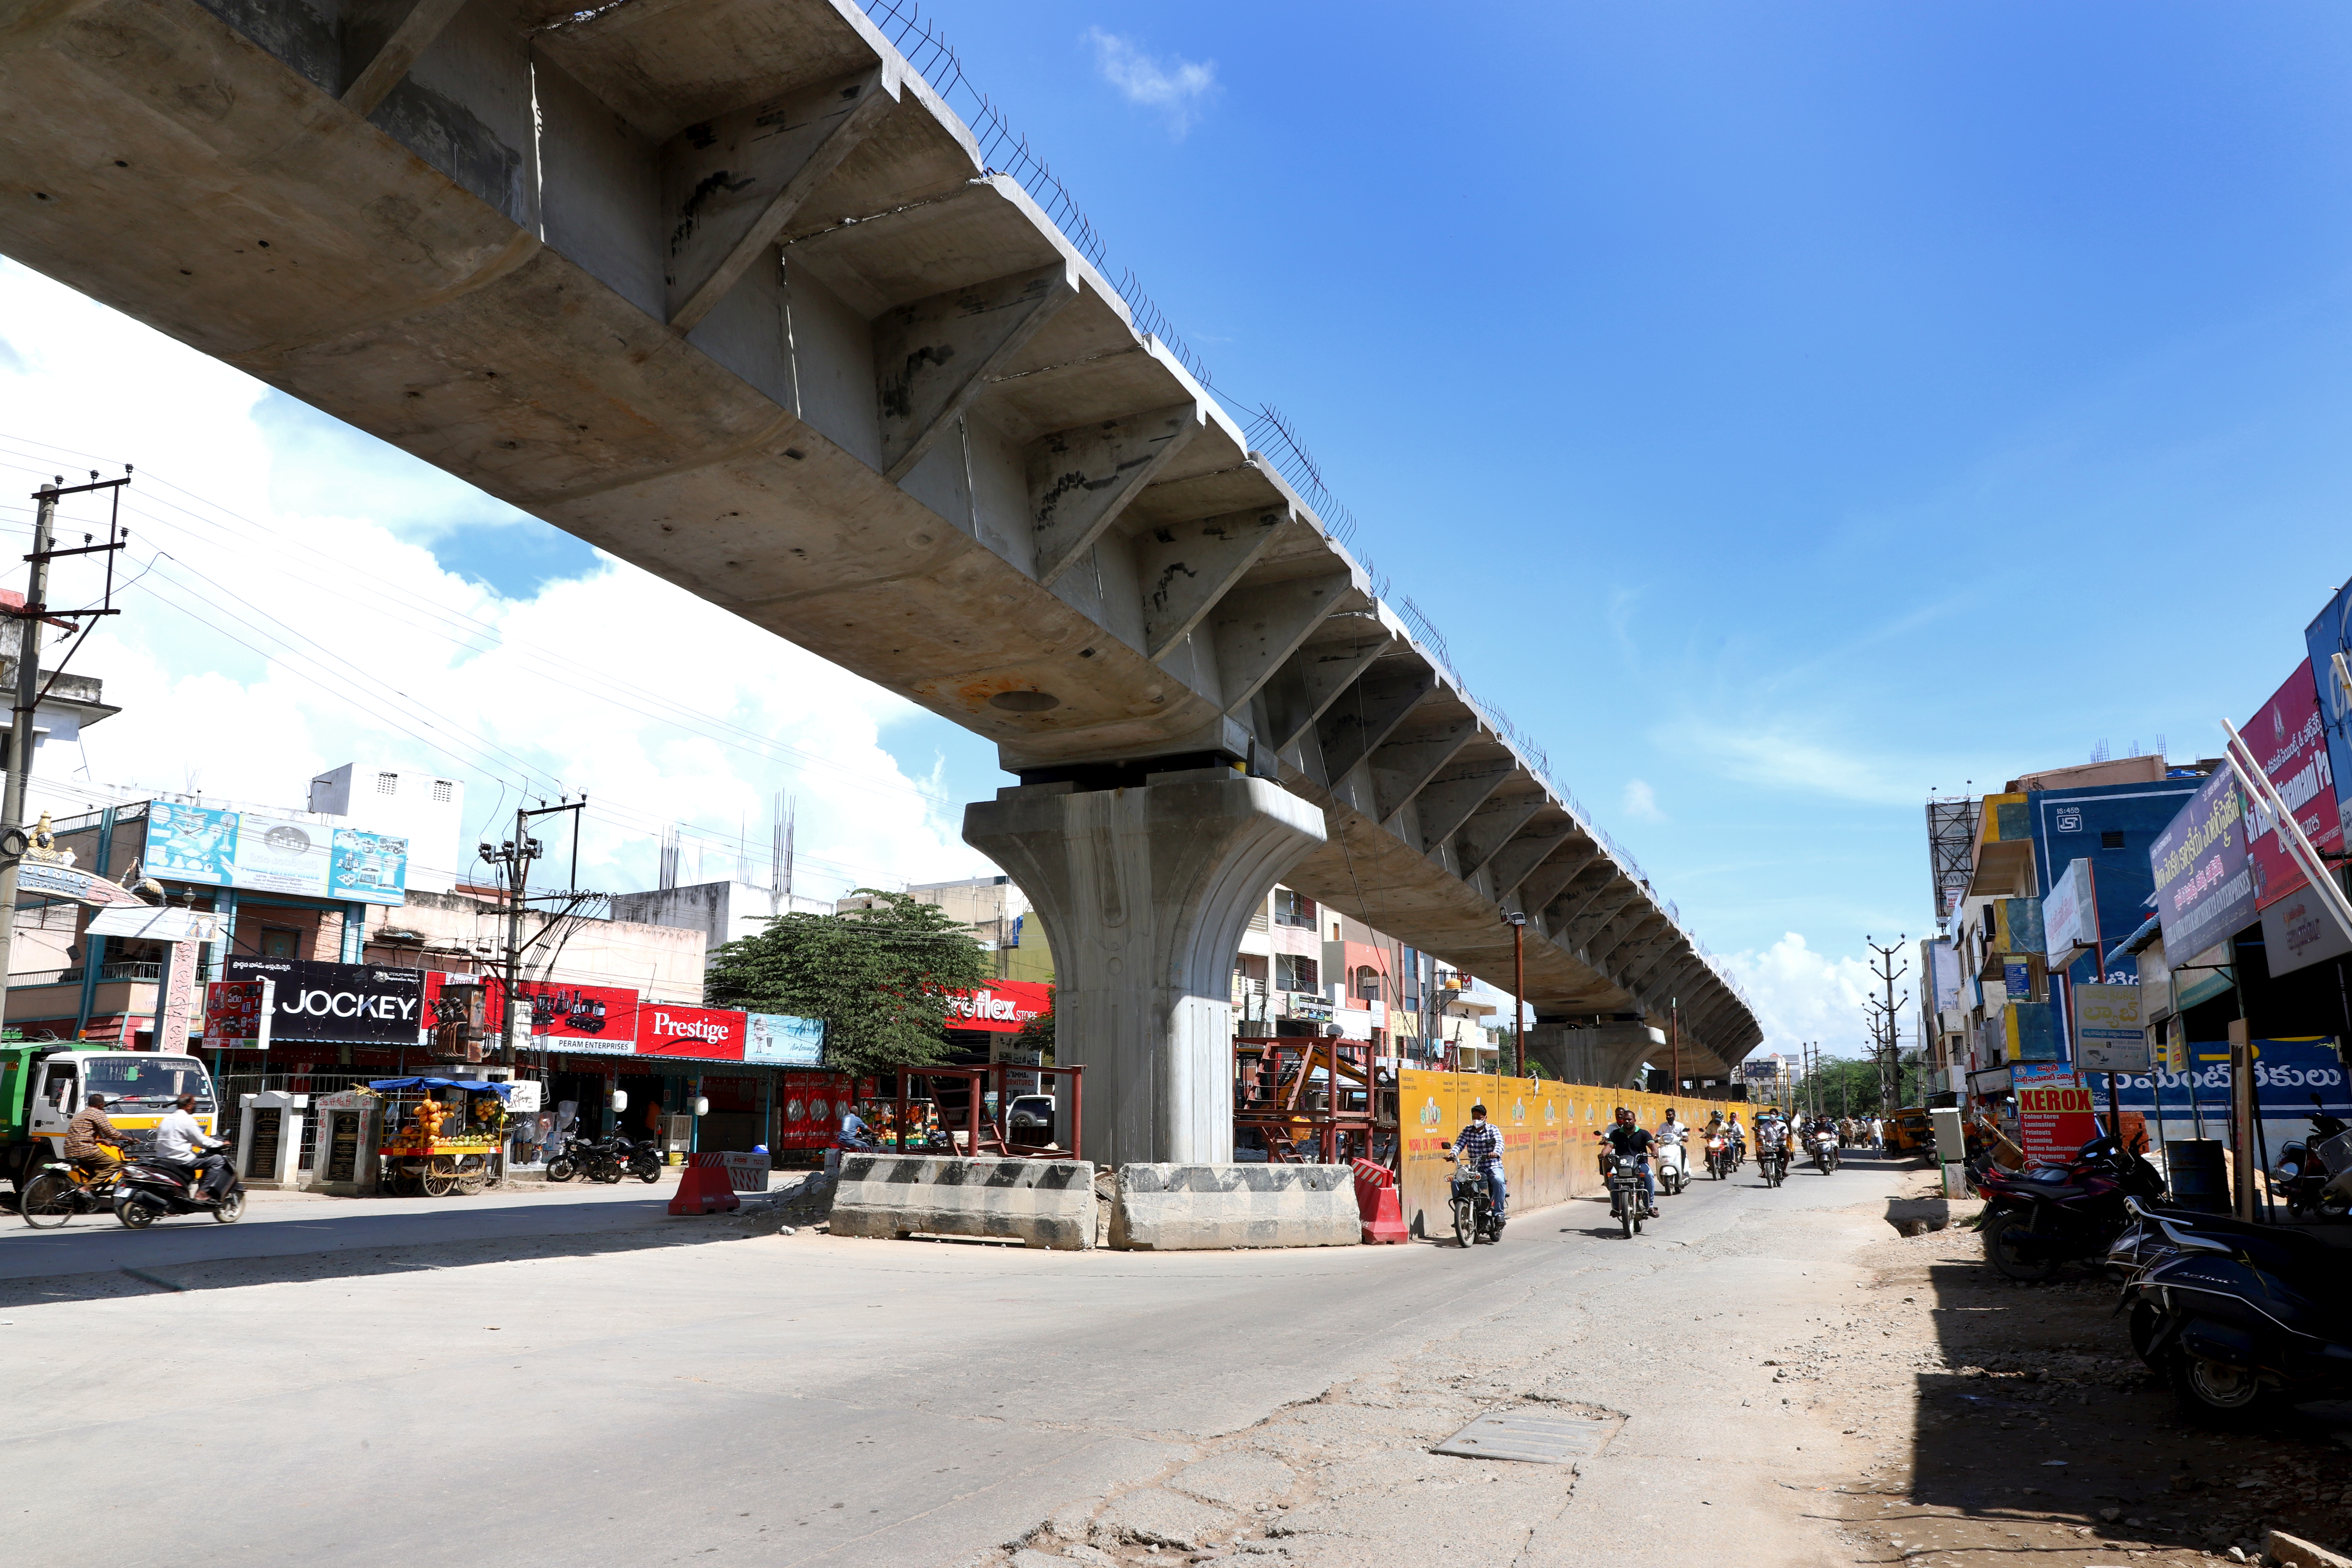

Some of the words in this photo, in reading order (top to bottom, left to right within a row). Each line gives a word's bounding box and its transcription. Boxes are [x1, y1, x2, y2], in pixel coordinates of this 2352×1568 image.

[2215, 867, 2251, 914] ENTERPRISES
[282, 990, 417, 1020] JOCKEY
[653, 1012, 729, 1044] Prestige
[559, 1040, 583, 1048] PERAM
[584, 1040, 629, 1050] ENTERPRISES
[1006, 1078, 1034, 1087] URNITURES
[2019, 1089, 2092, 1111] XEROX
[1409, 1139, 1421, 1152] WORK
[1423, 1138, 1428, 1150] IN
